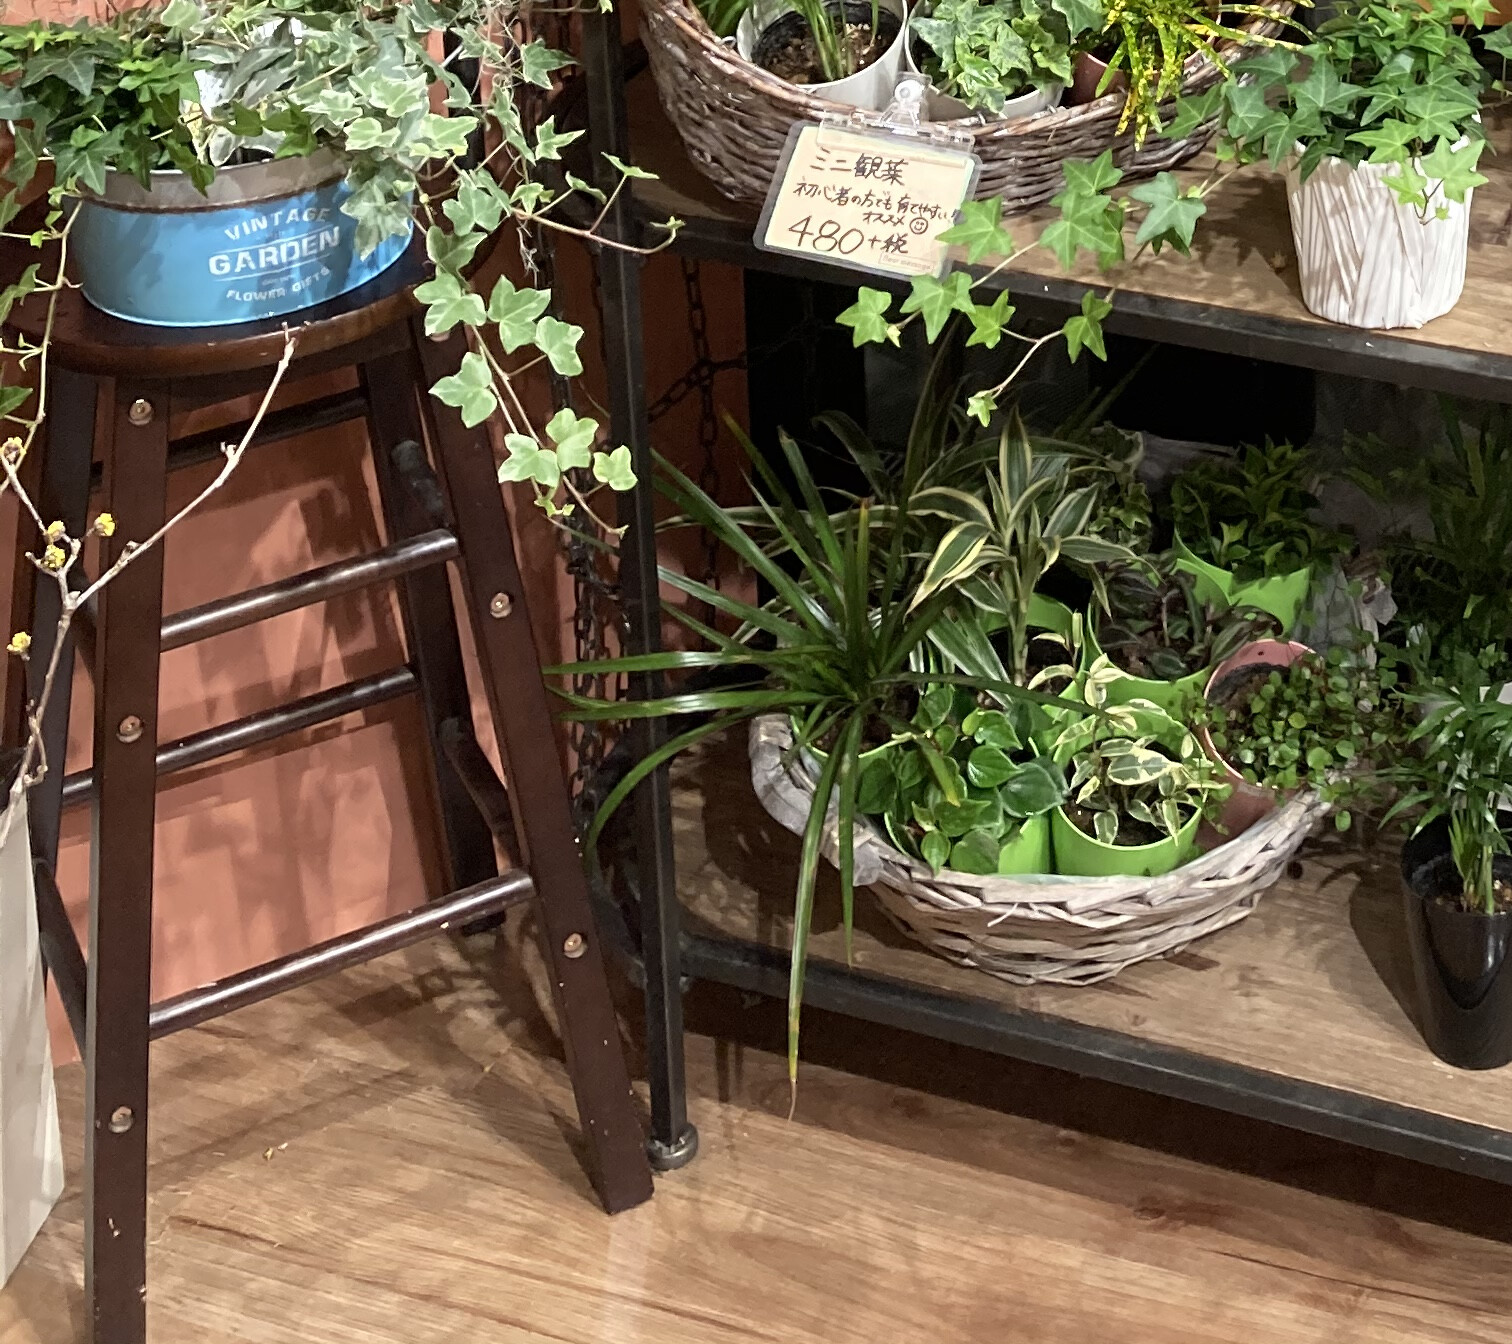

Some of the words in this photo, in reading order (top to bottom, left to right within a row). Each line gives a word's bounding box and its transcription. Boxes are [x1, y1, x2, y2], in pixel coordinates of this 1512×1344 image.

[810, 147, 909, 186] ミニ観葉
[224, 207, 331, 240] VINTAGE
[208, 226, 341, 275] GARDEN
[226, 286, 285, 302] FLOWER
[291, 267, 331, 292] GIFTS
